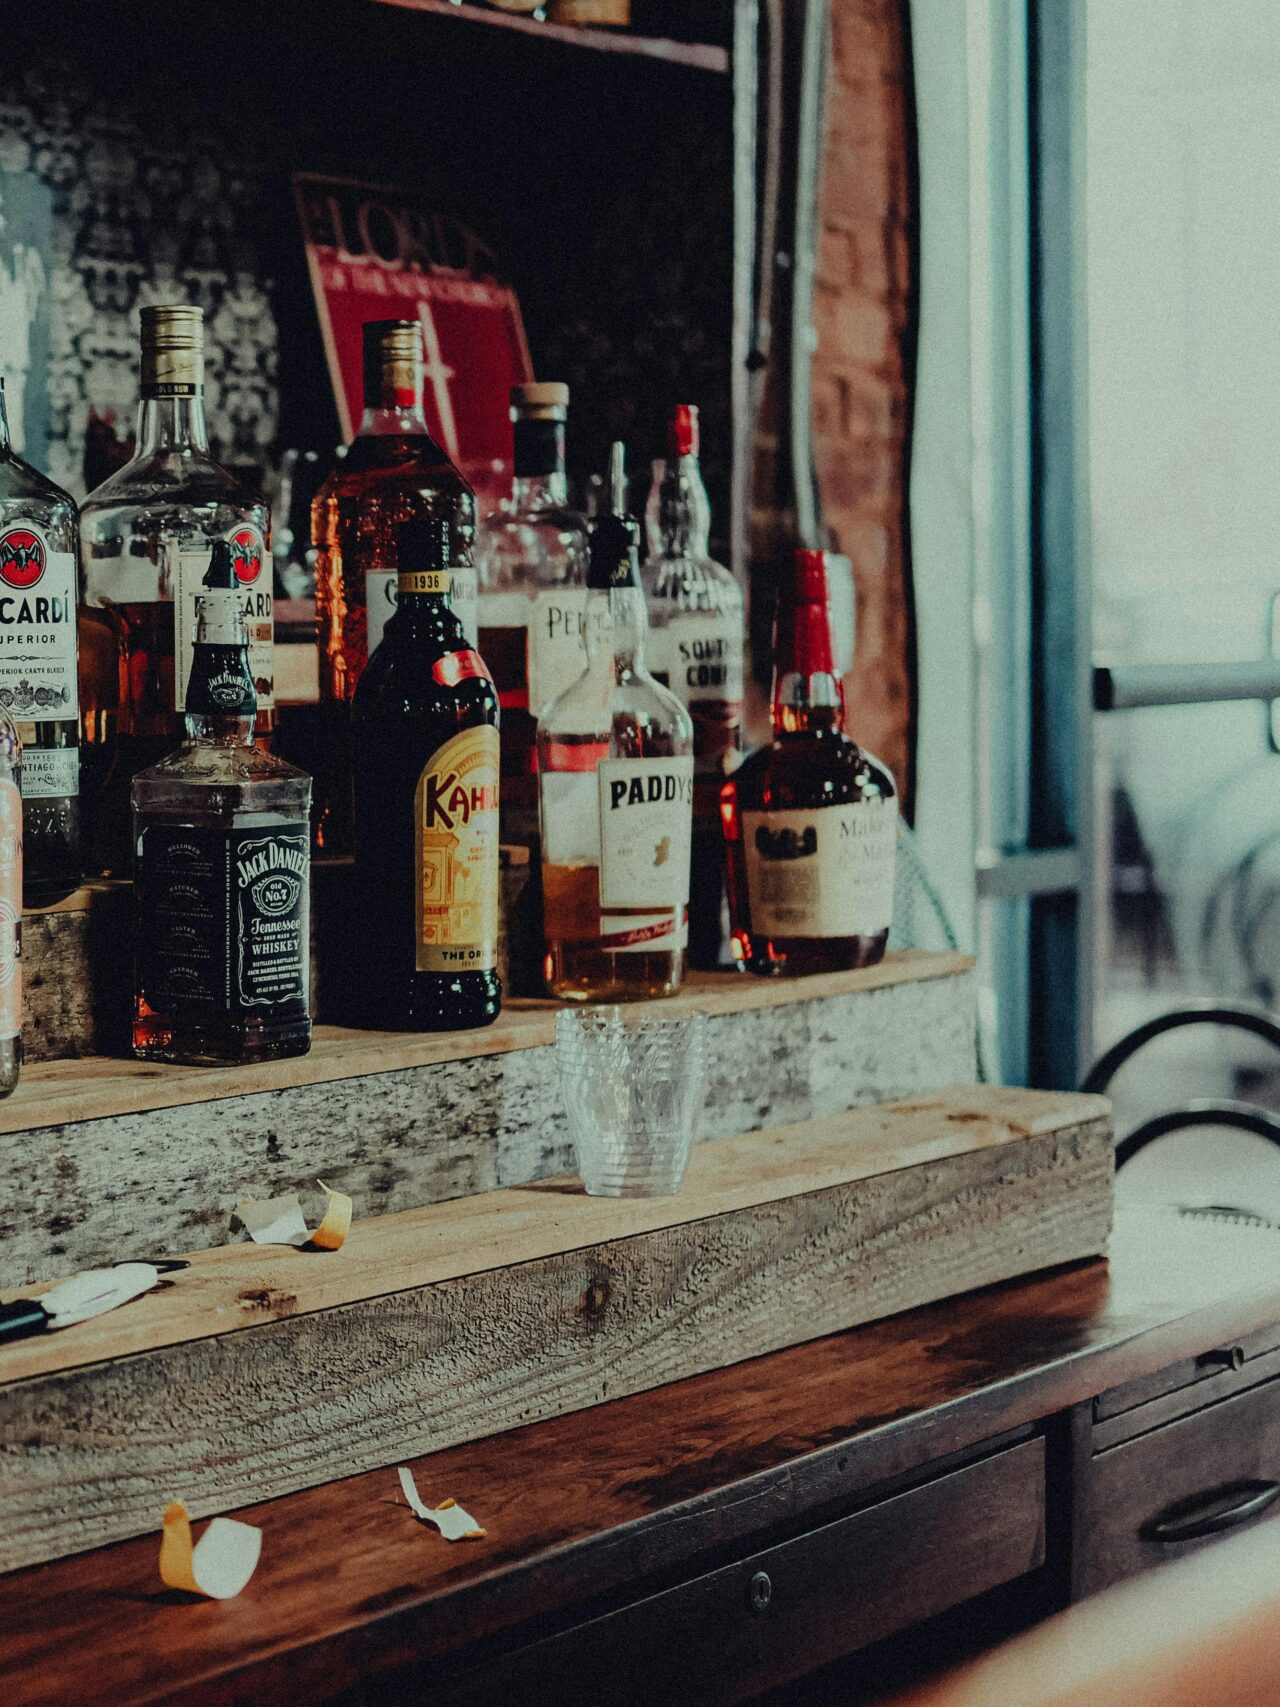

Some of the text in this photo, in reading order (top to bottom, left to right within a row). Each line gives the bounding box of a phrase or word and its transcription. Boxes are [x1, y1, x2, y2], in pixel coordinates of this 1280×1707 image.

[414, 575, 440, 589] 1936
[21, 762, 55, 772] NTIAGO
[236, 842, 311, 888] JACK DANIEL
[265, 889, 288, 902] No.7
[250, 917, 301, 935] Tennessee
[251, 939, 300, 956] WHISKEY
[441, 951, 465, 961] THE
